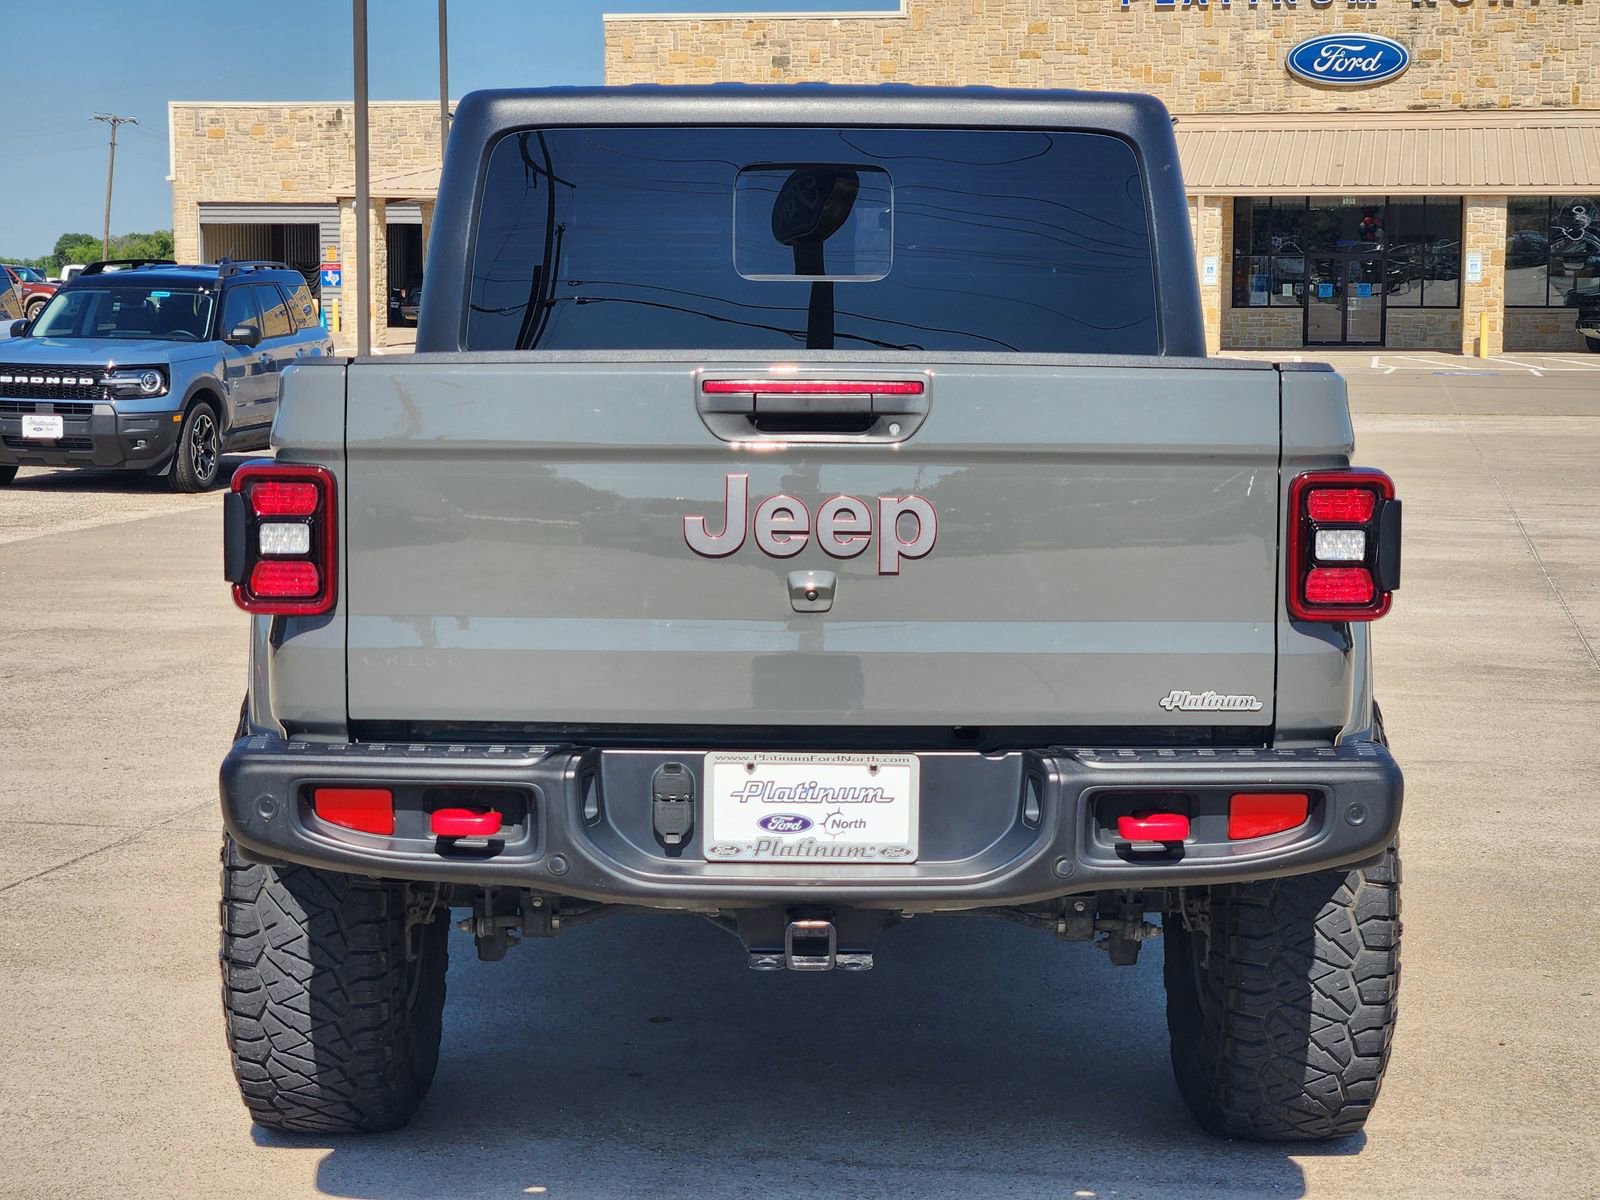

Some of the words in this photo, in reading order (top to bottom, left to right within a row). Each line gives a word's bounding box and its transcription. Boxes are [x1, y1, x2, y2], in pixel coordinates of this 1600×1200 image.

[1313, 44, 1383, 73] Ford
[0, 375, 94, 385] BRONCO
[682, 472, 939, 576] Jeep
[1159, 690, 1264, 711] Platinum
[714, 754, 911, 764] www.PlatinumFordNorth.com
[730, 780, 895, 804] Platinum
[767, 815, 803, 832] Ford
[831, 818, 867, 830] North
[752, 839, 875, 858] Platinum
